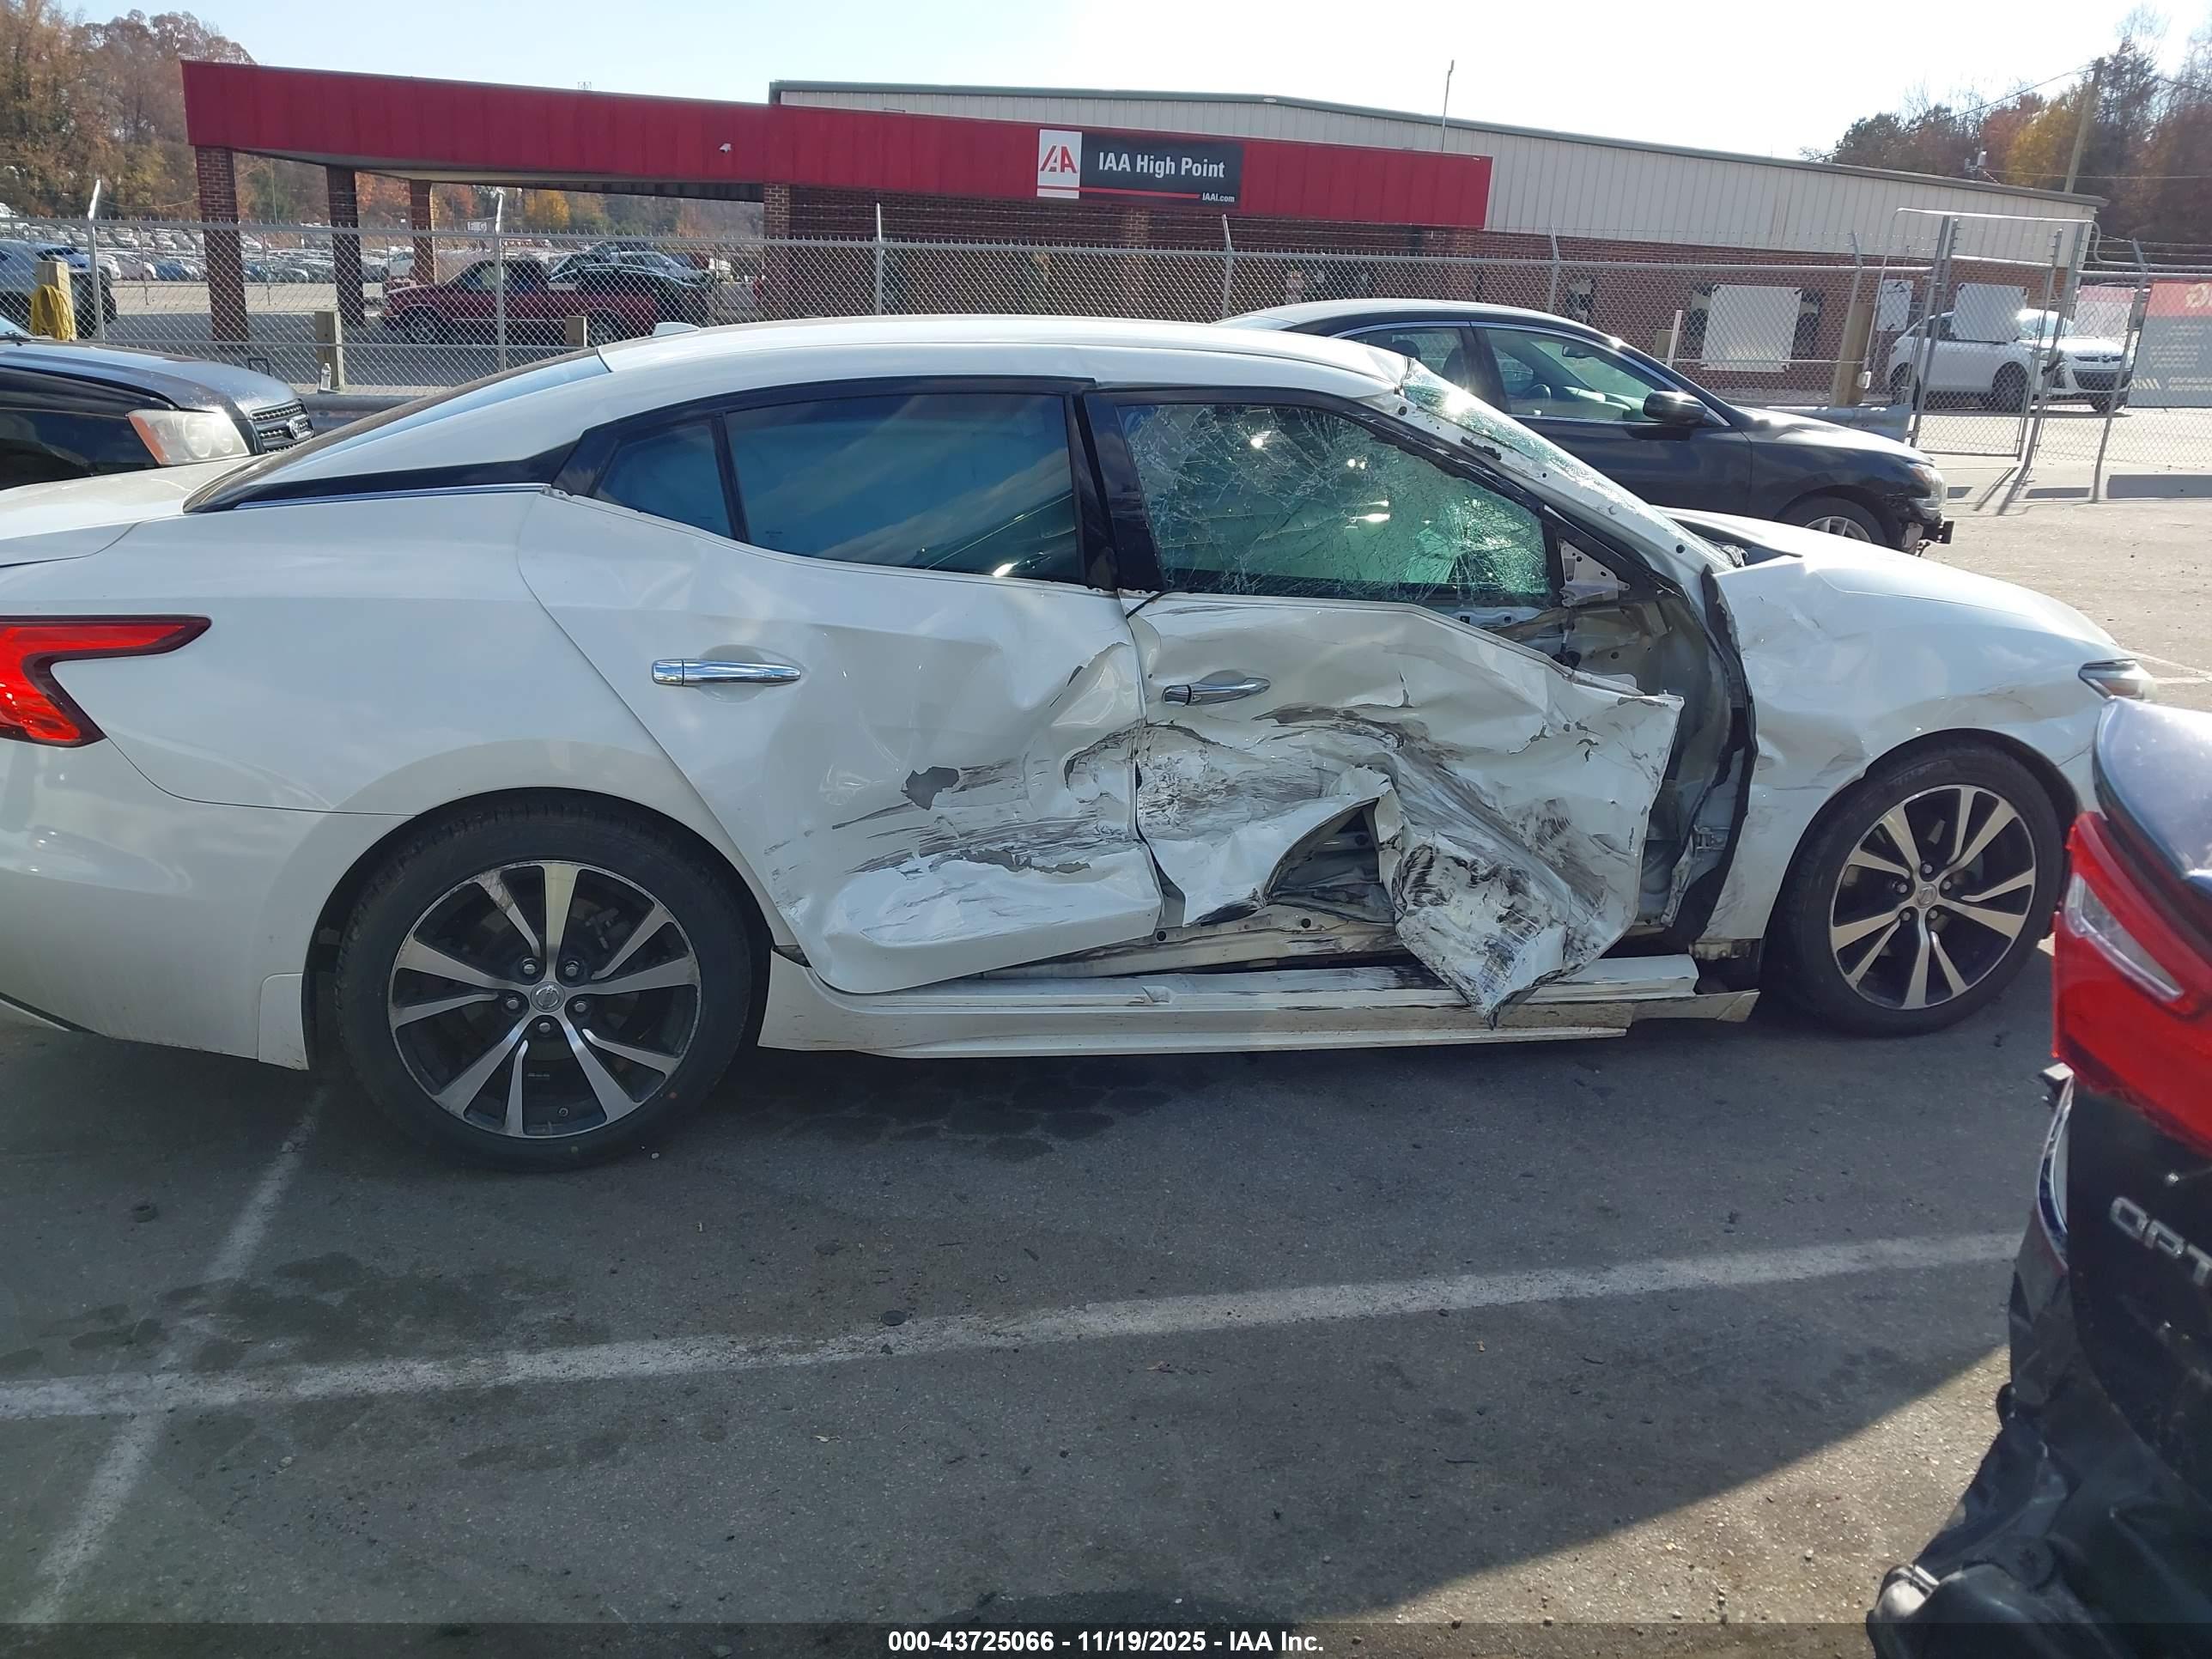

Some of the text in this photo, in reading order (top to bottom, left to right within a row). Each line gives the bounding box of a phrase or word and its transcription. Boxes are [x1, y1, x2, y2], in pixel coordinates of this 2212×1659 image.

[1098, 151, 1225, 179] IAA High Point
[1202, 192, 1235, 203] IAAI.com
